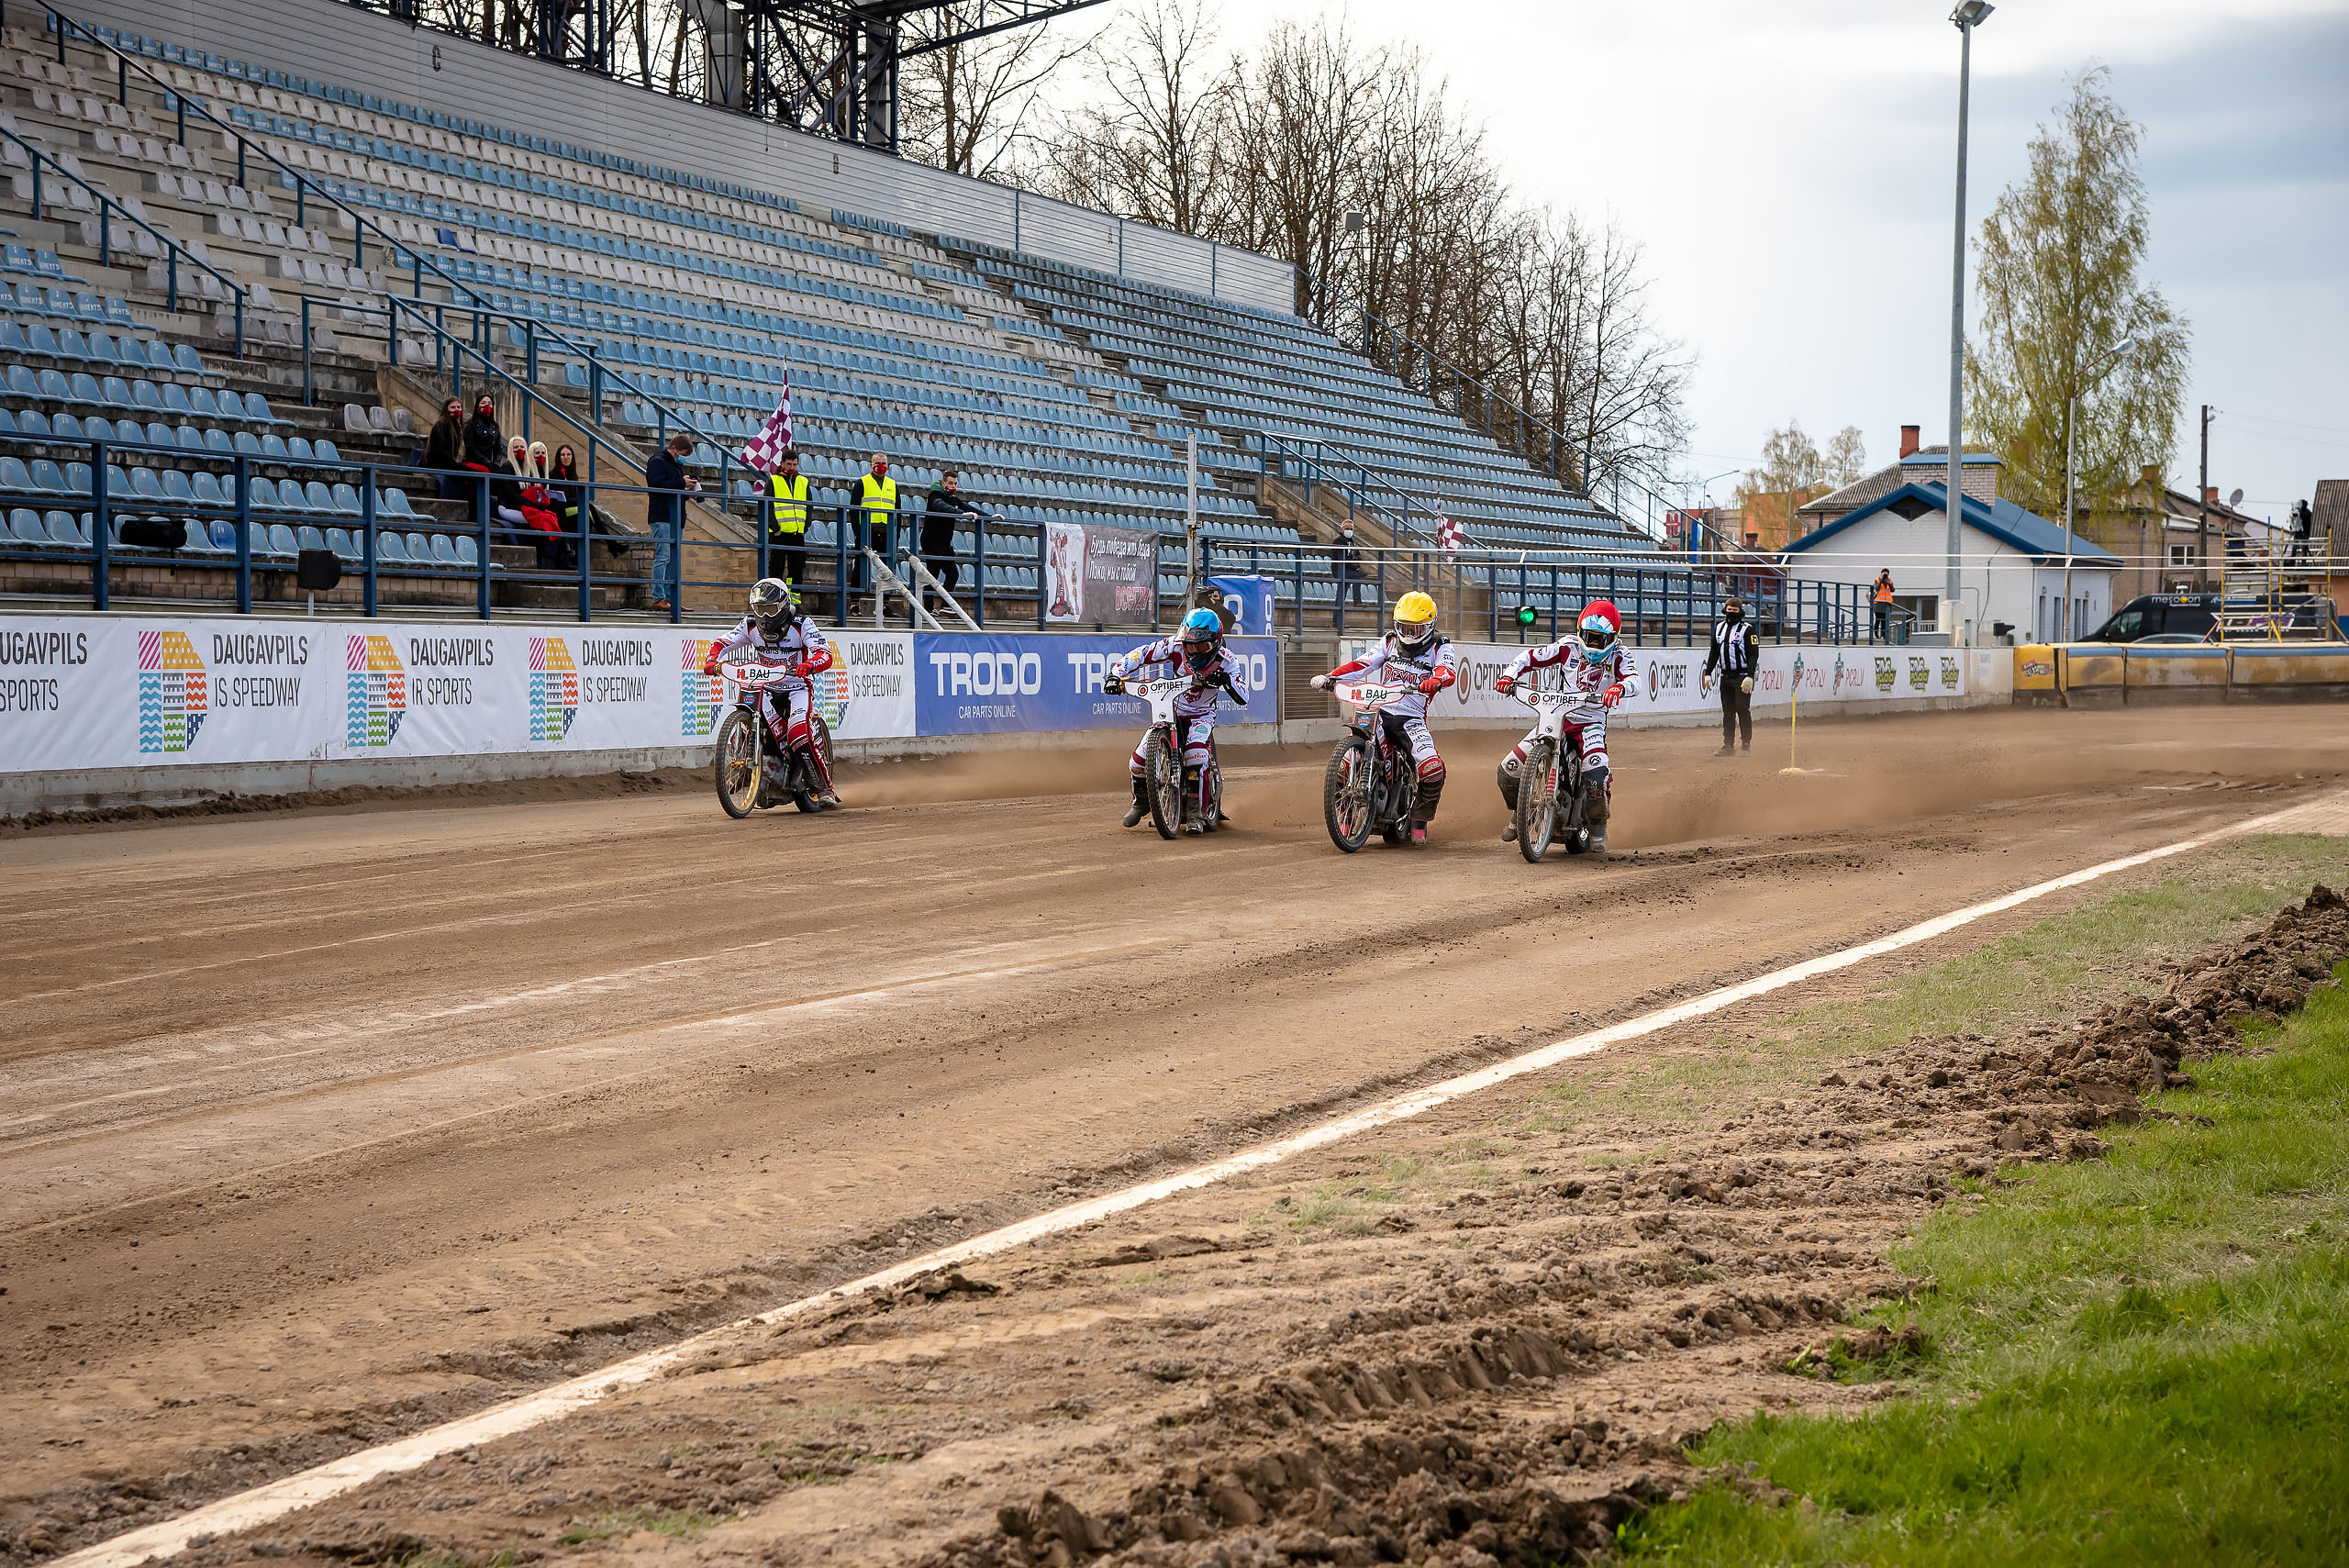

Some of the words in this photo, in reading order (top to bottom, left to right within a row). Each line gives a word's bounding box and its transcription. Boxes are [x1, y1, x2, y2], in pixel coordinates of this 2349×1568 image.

[1090, 535, 1106, 558] Будь
[1106, 537, 1127, 558] победа
[1137, 539, 1151, 560] беда
[1089, 561, 1106, 583] Локо,
[1120, 563, 1137, 582] тобой
[213, 634, 308, 665] DAUGAVPILS
[410, 638, 494, 666] DAUGAVPILS
[582, 639, 652, 666] DAUGAVPILS
[850, 642, 904, 666] DAUGAVPILS
[750, 669, 770, 679] BAU
[930, 651, 1042, 695] TRODO
[1474, 662, 1510, 691] OPTIB
[1660, 664, 1687, 689] OPTIBET
[215, 677, 228, 707] IS
[232, 677, 301, 707] SPEEDWAY
[412, 678, 423, 706] IR
[428, 677, 473, 706] SPORTS
[583, 676, 593, 703] IS
[596, 676, 648, 703] SPEEDWAY
[852, 674, 861, 698] IS
[862, 674, 902, 697] SPEEDWAY
[1150, 681, 1185, 692] OPTIBET
[1366, 689, 1387, 699] BAU
[958, 706, 972, 719] CAR
[972, 705, 993, 718] PARTS
[993, 704, 1016, 718] ONLINE
[1092, 703, 1105, 715] CAR
[1105, 703, 1123, 714] PARTS
[1123, 702, 1141, 714] ONLINE
[1542, 694, 1578, 705] OPTIBET
